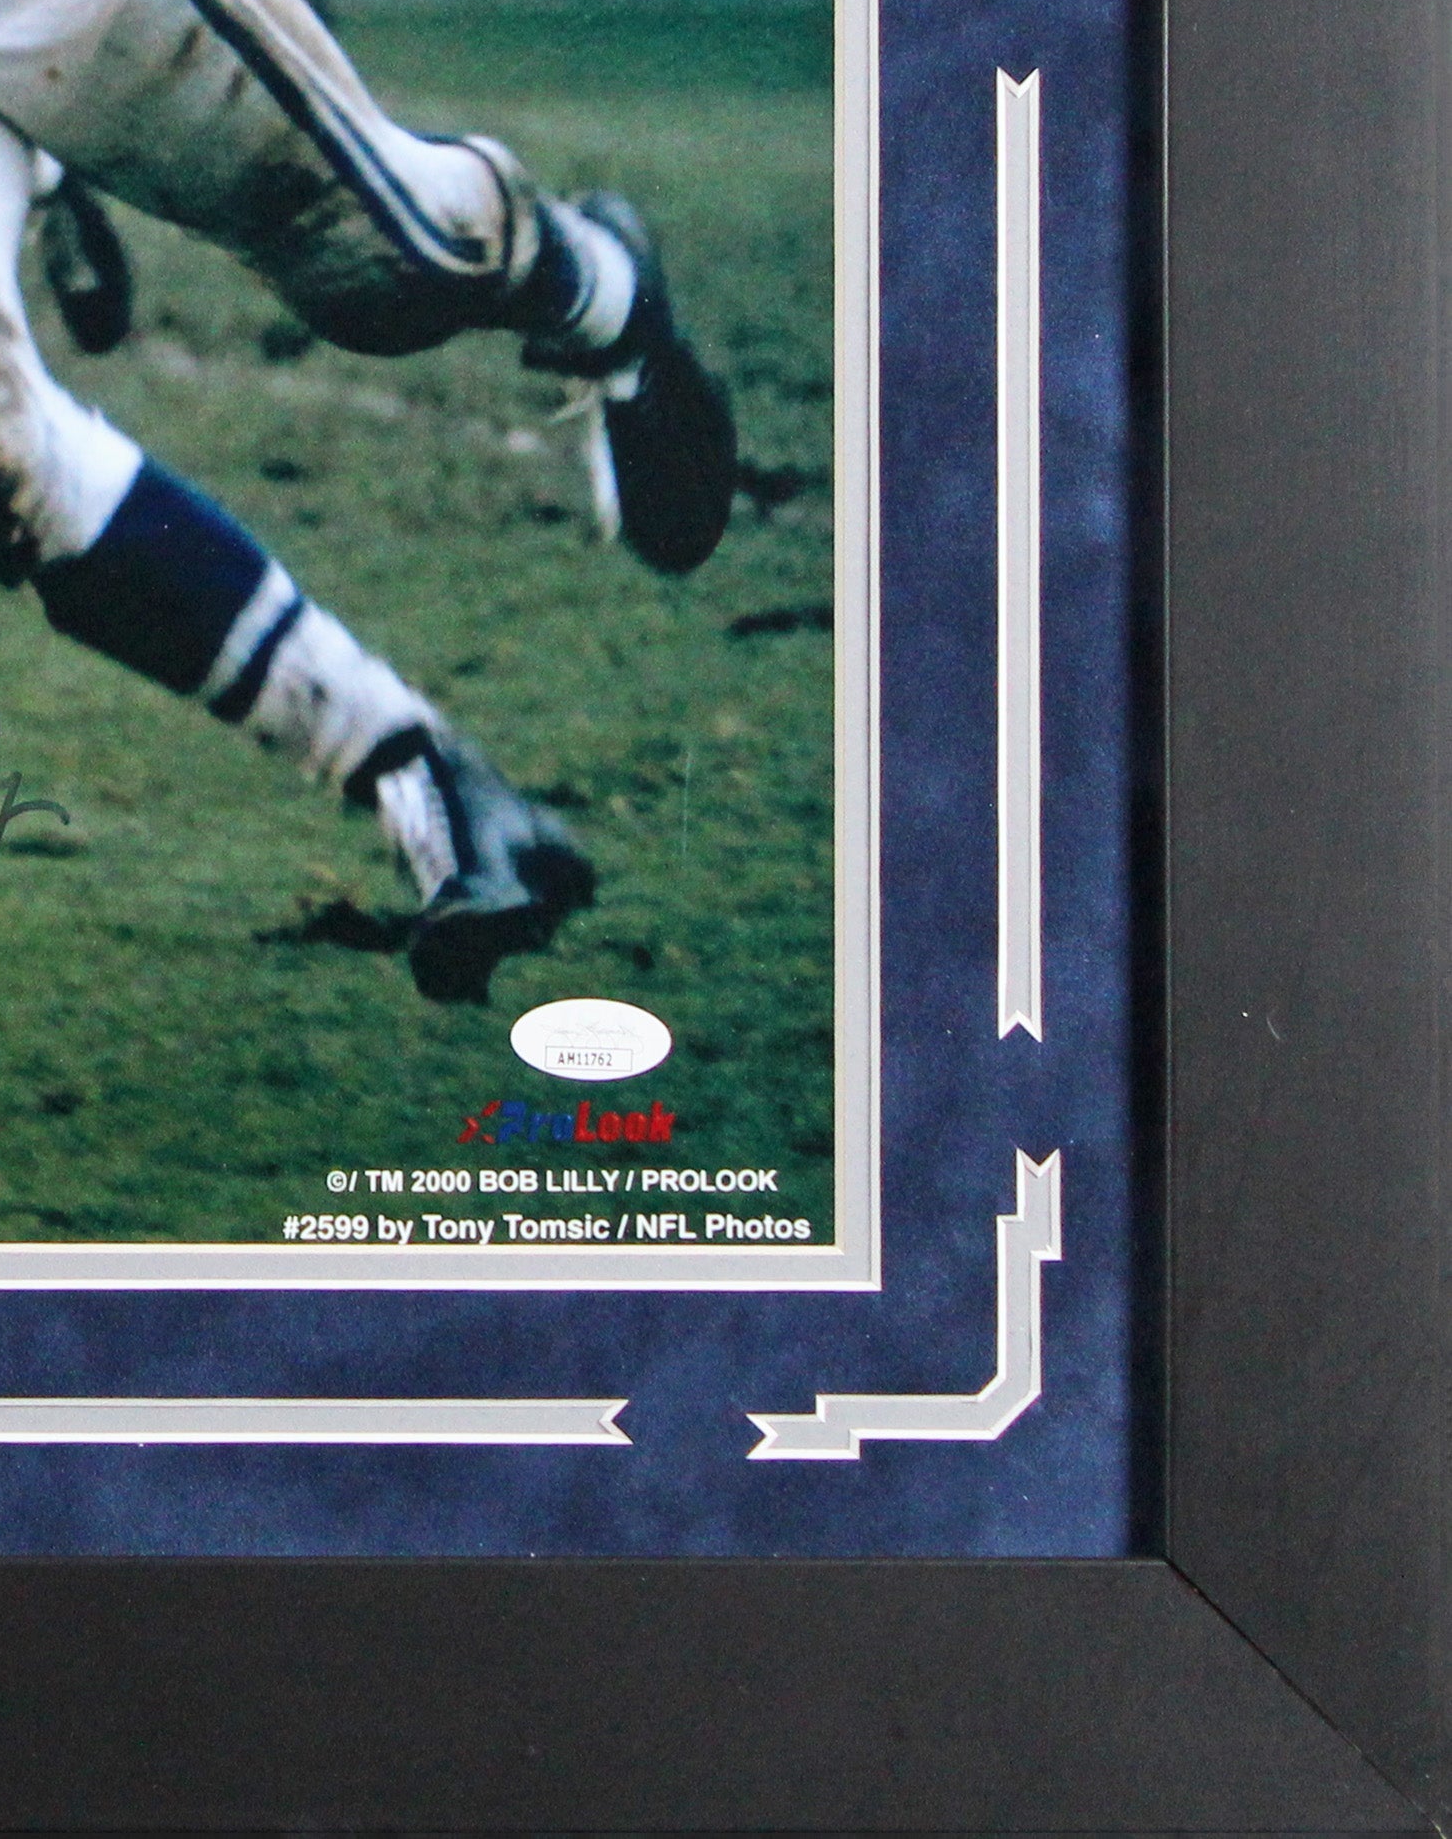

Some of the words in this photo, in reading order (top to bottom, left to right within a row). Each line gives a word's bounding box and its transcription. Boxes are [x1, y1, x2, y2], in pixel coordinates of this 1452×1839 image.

[556, 1051, 614, 1068] AM11762
[365, 1170, 404, 1193] TM
[411, 1169, 472, 1193] 2000
[479, 1169, 539, 1193] BOB
[546, 1169, 620, 1193] LILLY
[642, 1168, 778, 1192] PROLOOK
[282, 1214, 370, 1241] #2599
[377, 1214, 414, 1245] by
[421, 1214, 495, 1245] Tony
[503, 1213, 611, 1240] Tomsic
[636, 1213, 698, 1239] NFL
[705, 1213, 811, 1240] Photos
